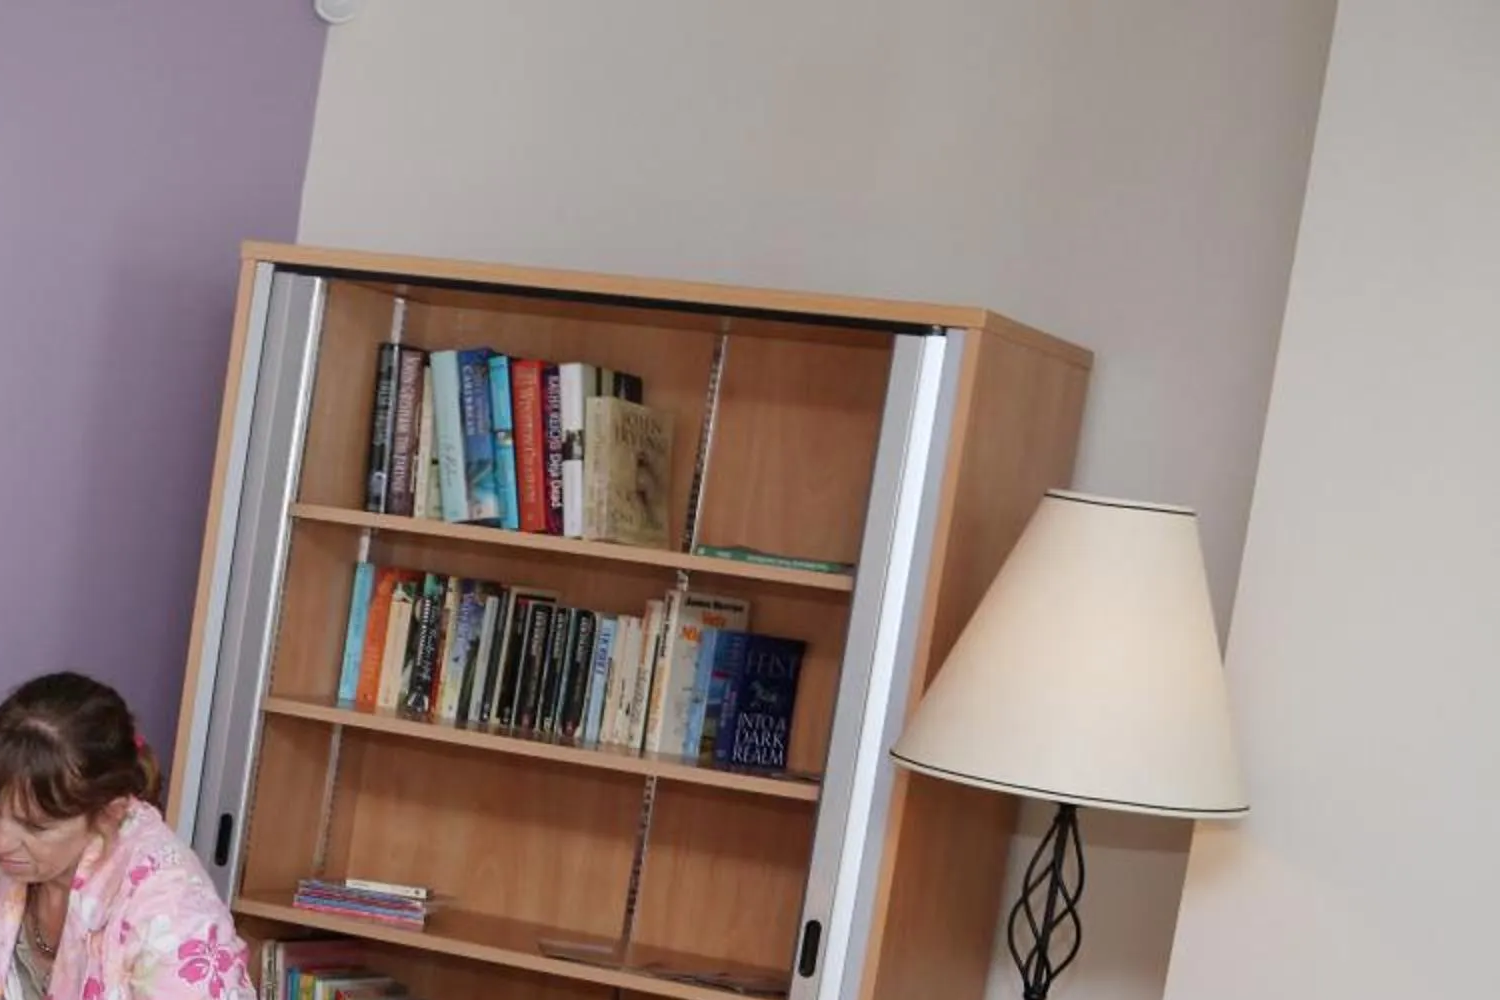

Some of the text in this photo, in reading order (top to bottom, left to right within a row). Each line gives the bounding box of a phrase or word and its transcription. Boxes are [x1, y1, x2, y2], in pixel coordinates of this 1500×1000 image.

[737, 711, 787, 730] INTO A
[734, 727, 784, 749] DARK
[731, 747, 784, 766] REALM
